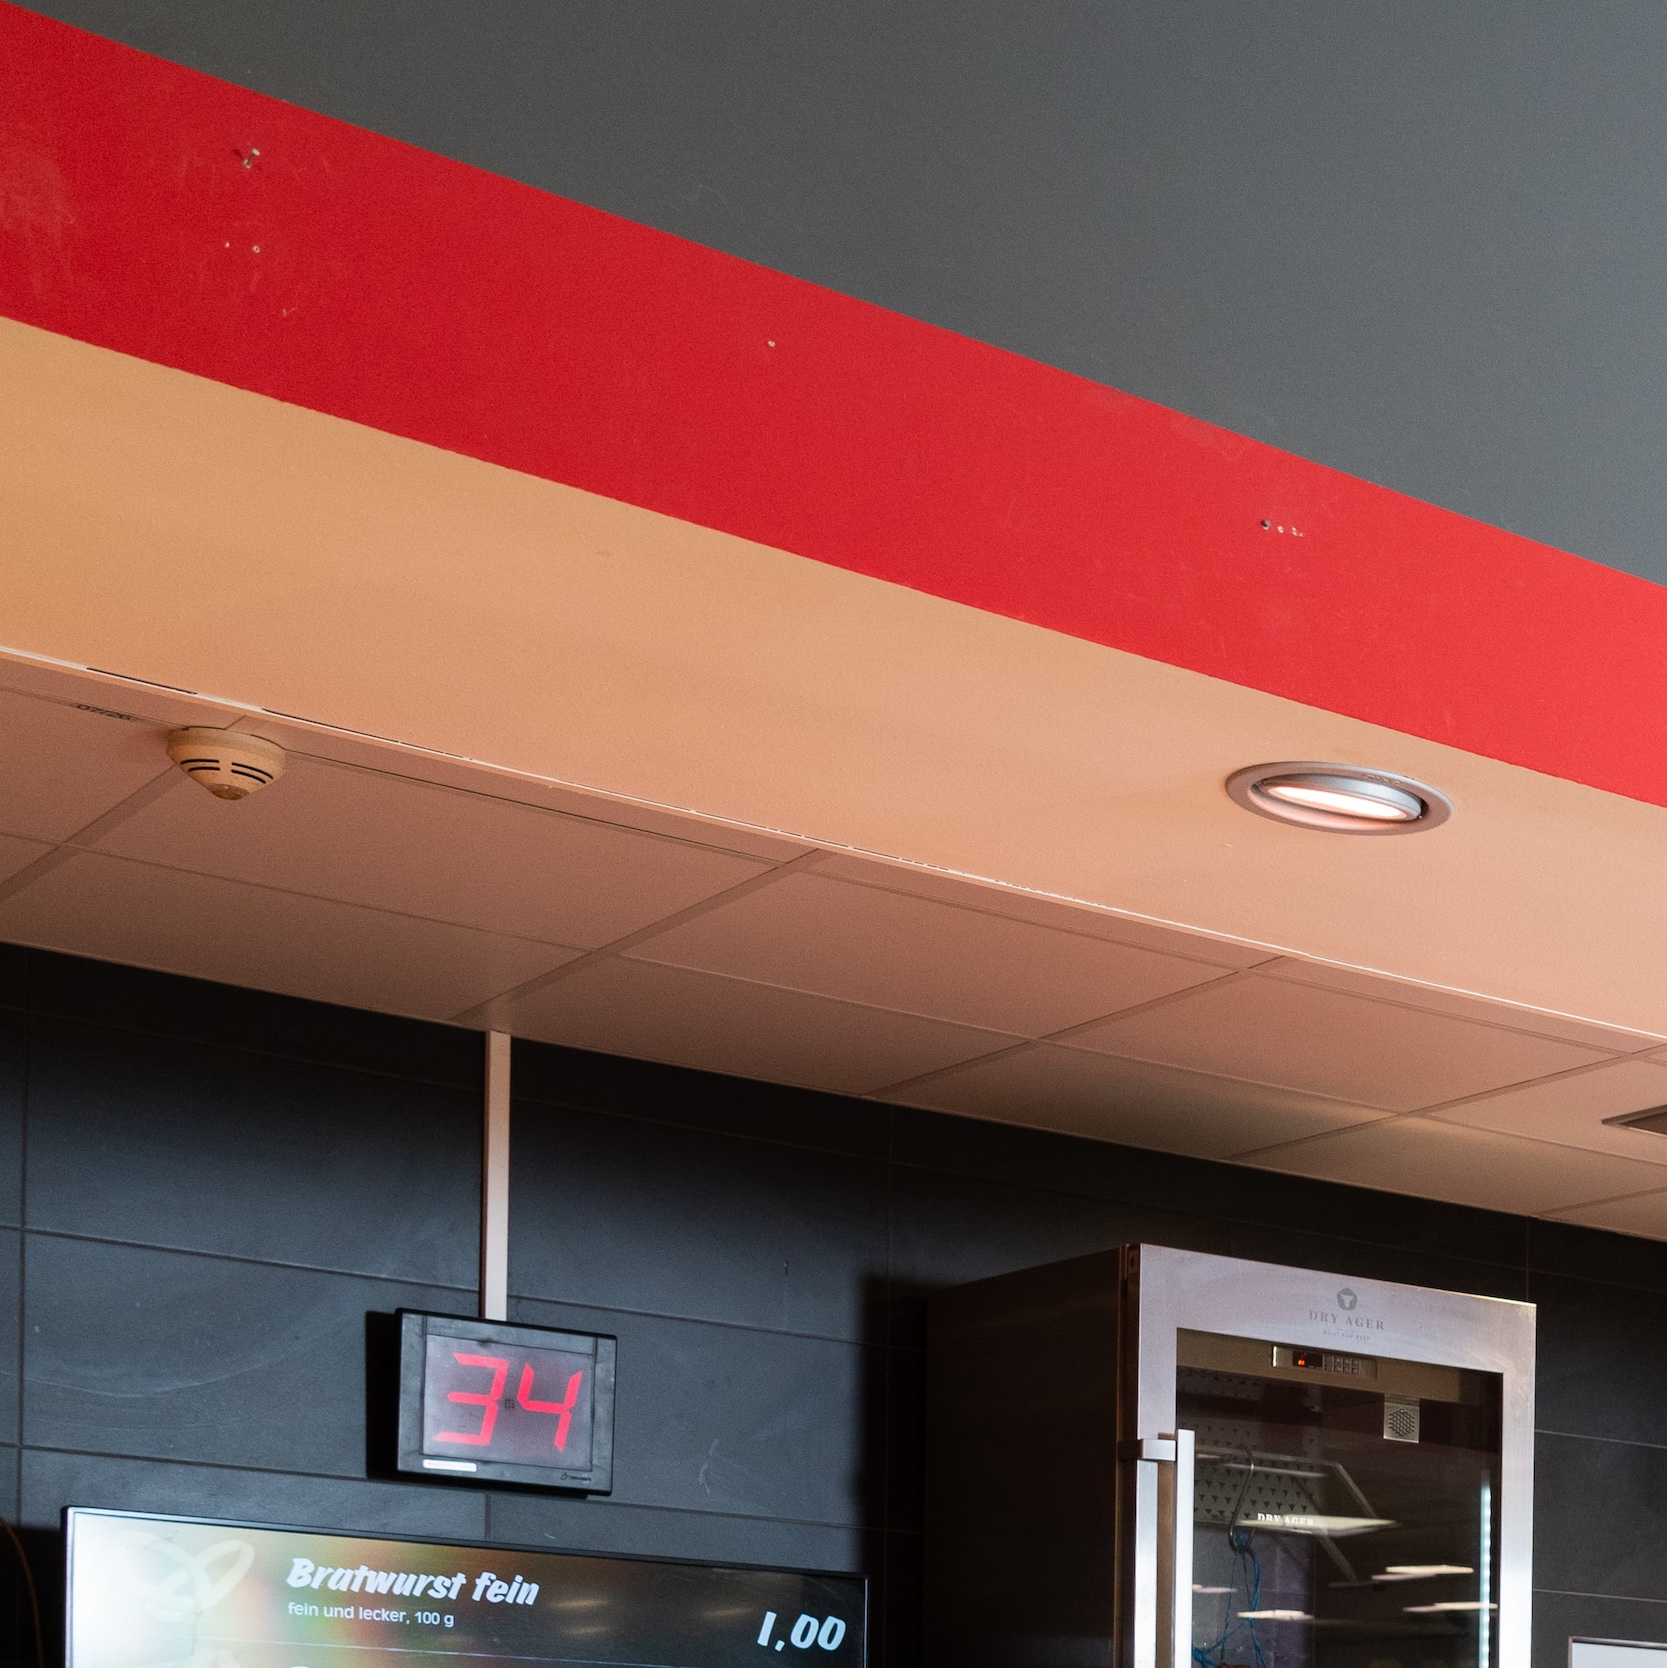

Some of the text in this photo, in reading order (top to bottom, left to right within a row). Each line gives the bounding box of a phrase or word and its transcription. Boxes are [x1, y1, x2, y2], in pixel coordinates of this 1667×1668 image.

[1309, 1310, 1385, 1331] DRY AGER
[433, 1352, 583, 1453] 34
[286, 1558, 540, 1605] Bratwurst fein
[288, 1602, 454, 1627] fein und lecker, 100 g
[757, 1611, 846, 1651] 1,00
